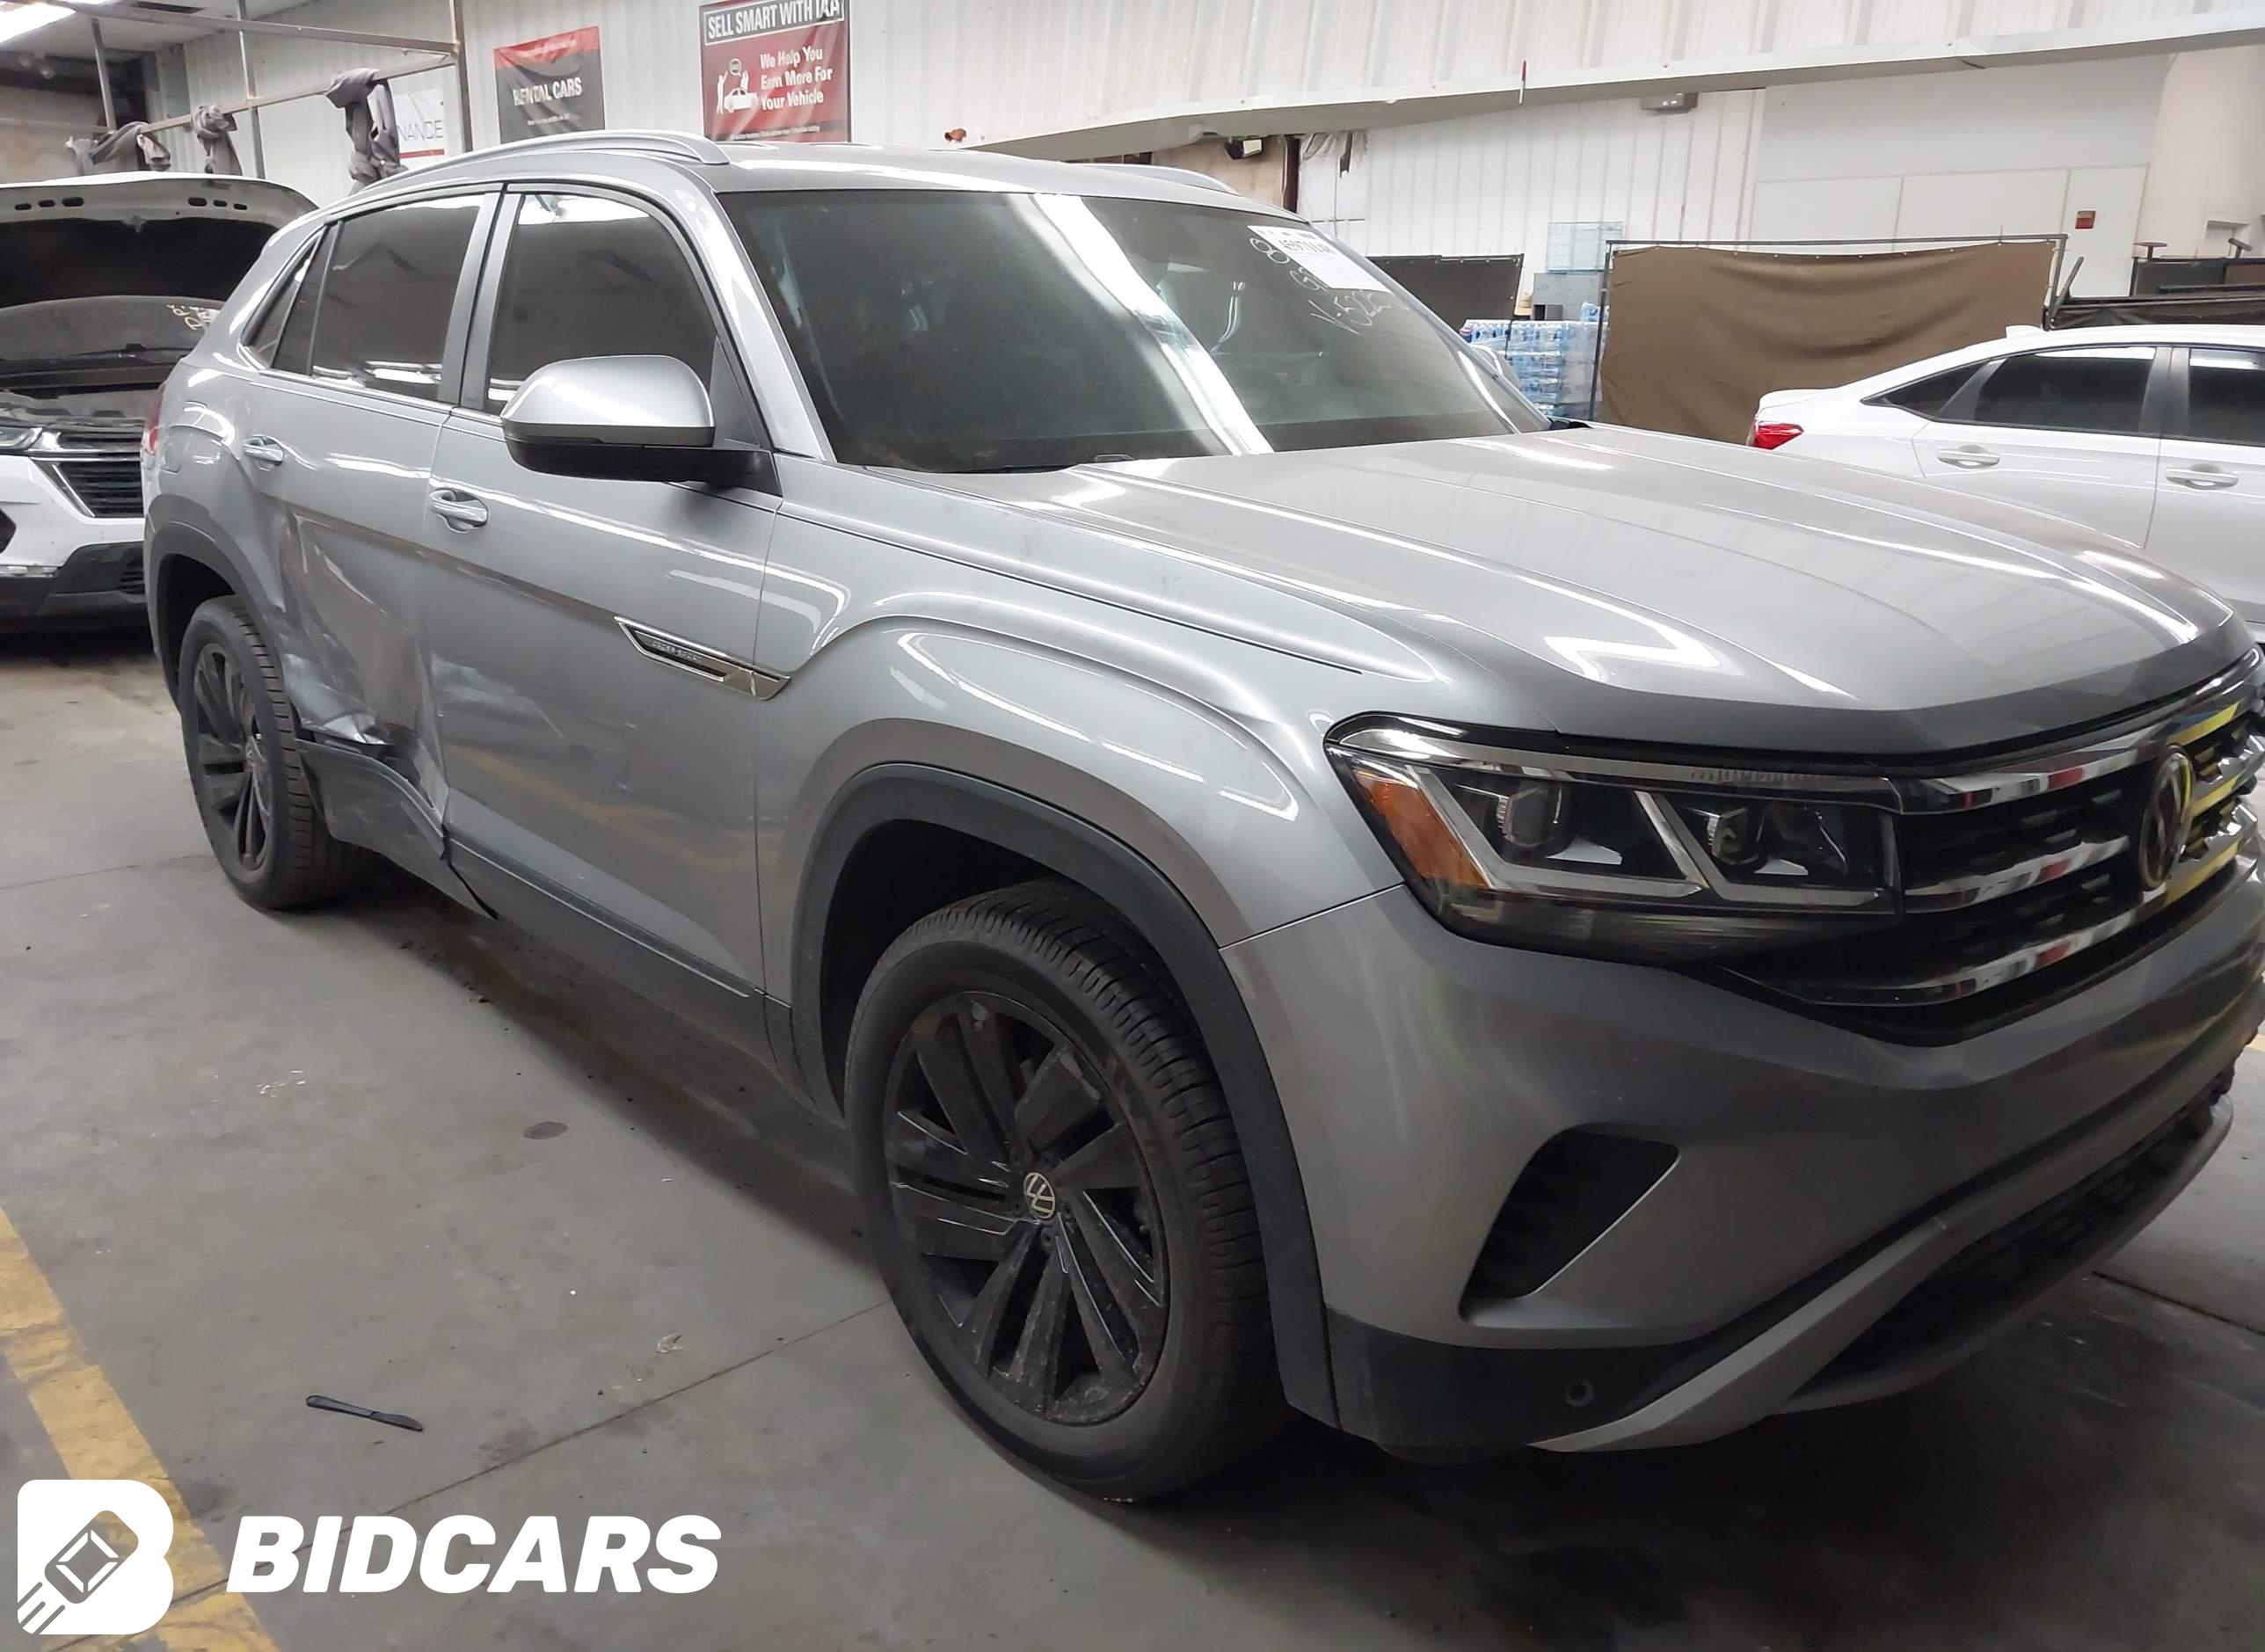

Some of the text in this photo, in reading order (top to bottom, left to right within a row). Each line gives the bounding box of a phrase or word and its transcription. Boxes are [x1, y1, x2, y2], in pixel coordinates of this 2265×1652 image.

[708, 14, 734, 40] SELL
[735, 4, 778, 33] SMART
[779, 0, 812, 26] WITH
[760, 46, 823, 69] We Help You
[761, 66, 834, 90] Earn More For
[513, 76, 582, 106] RENTAL CARS
[761, 89, 825, 111] Your Vehicle
